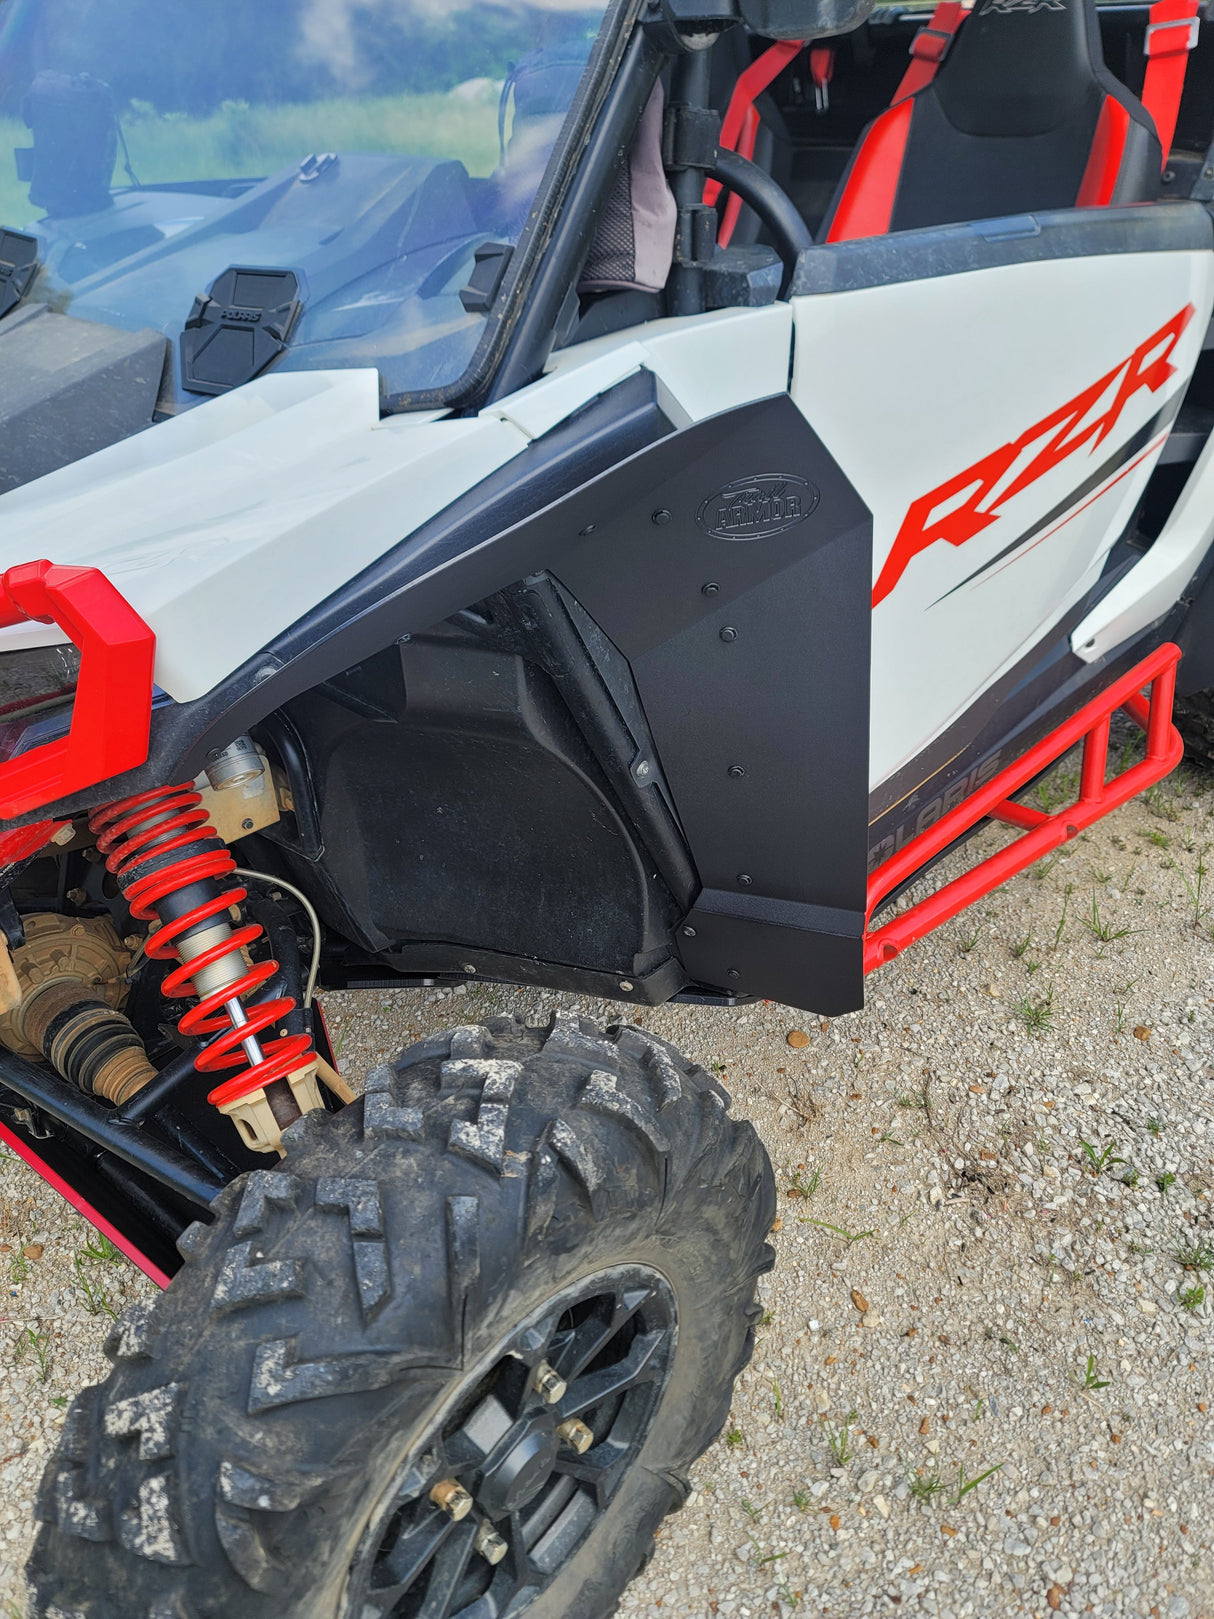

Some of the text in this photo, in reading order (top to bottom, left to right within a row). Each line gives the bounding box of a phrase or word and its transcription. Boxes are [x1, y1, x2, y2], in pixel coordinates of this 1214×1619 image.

[221, 308, 262, 323] POLARIS
[872, 301, 1196, 610] RZR
[715, 496, 802, 531] ARMOR
[868, 750, 1001, 877] OLARIS
